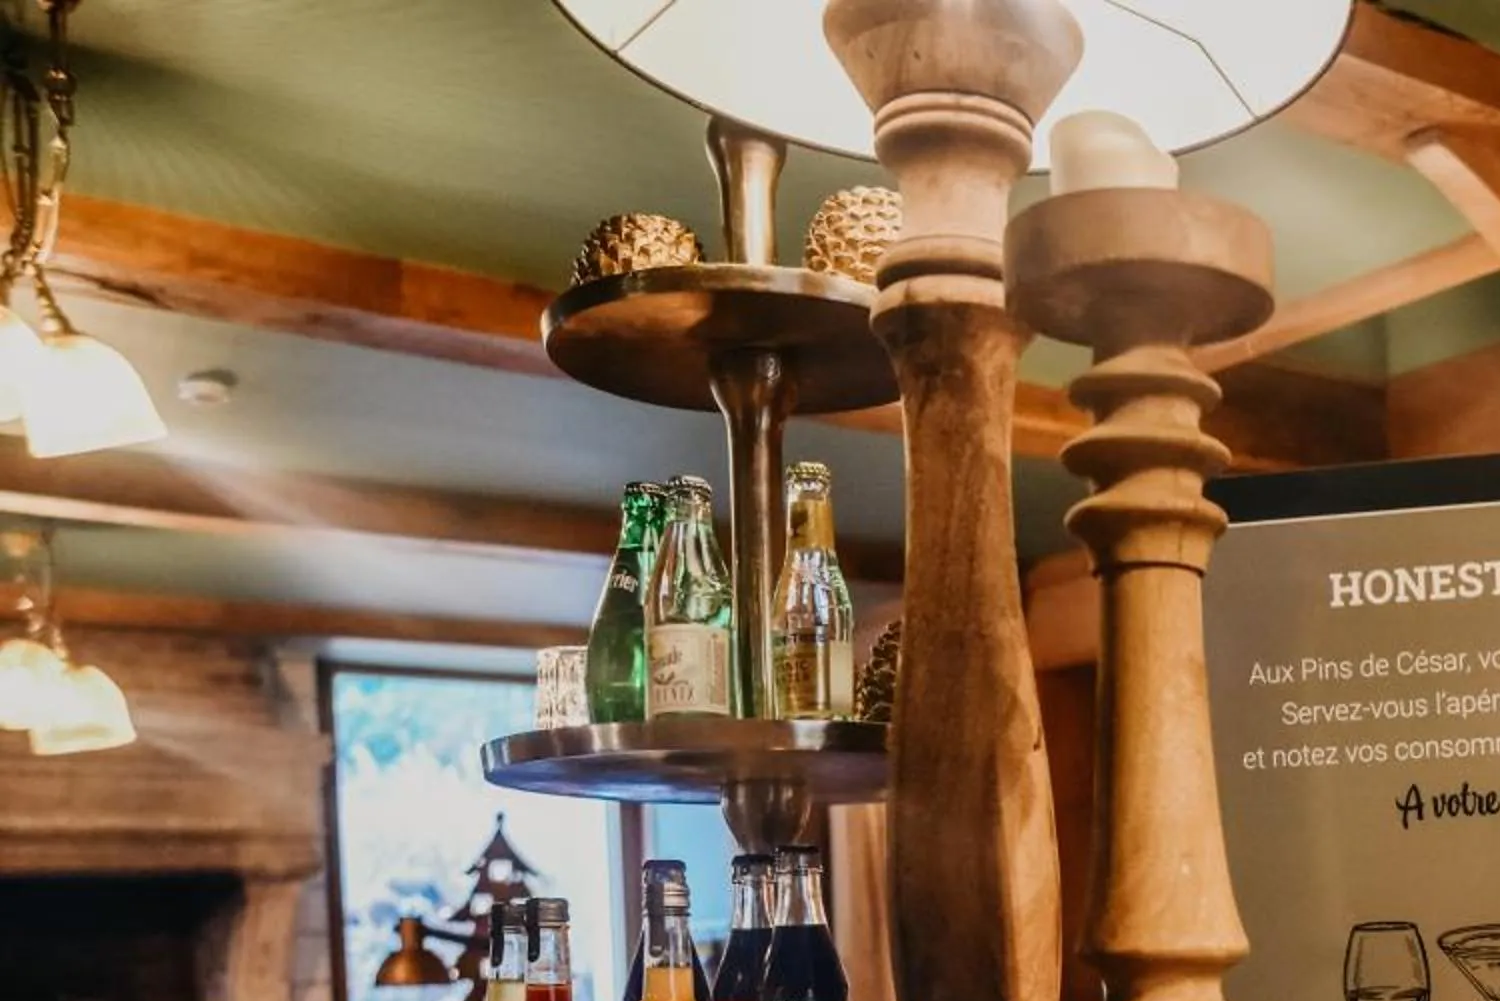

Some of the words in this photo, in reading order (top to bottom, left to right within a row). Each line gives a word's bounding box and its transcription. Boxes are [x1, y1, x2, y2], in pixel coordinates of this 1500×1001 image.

[1249, 661, 1295, 686] Aux
[1300, 657, 1353, 682] Pins
[1359, 653, 1390, 677] de
[1396, 649, 1472, 676] César,
[1280, 696, 1429, 726] Servez-vous
[1242, 747, 1267, 770] et
[1271, 744, 1340, 769] notez
[1344, 742, 1389, 765] vos
[1394, 782, 1426, 831] A
[1431, 780, 1500, 819] votre
